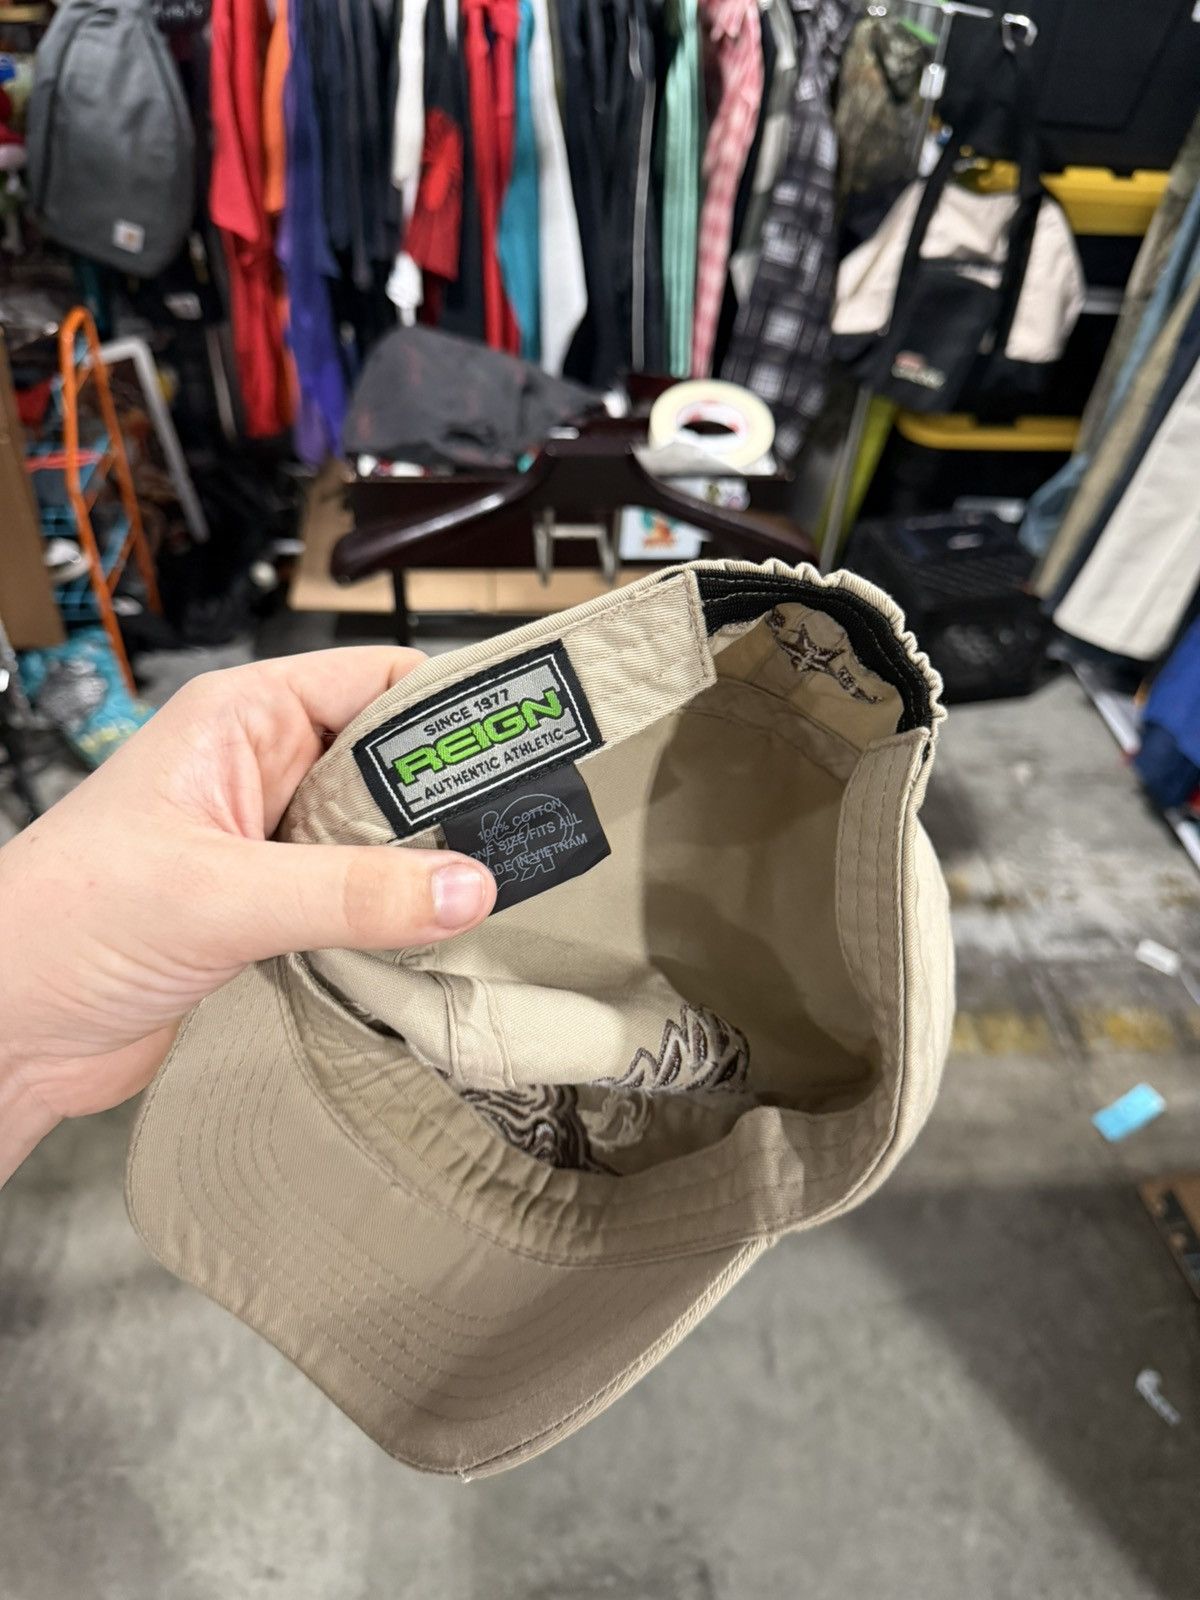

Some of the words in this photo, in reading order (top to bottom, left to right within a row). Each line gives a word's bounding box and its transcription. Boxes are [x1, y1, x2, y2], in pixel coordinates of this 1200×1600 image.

[423, 706, 472, 737] SINCE
[474, 689, 510, 714] 1977
[393, 687, 565, 785] REIGN
[424, 756, 501, 799] AUTHENTIC
[503, 728, 564, 764] ATHLETIC
[479, 821, 509, 840] 100%
[512, 798, 562, 824] COTTON
[499, 834, 526, 852] SIZE
[528, 822, 556, 840] FITS
[559, 813, 583, 830] ALL
[531, 833, 588, 863] VIETNAM
